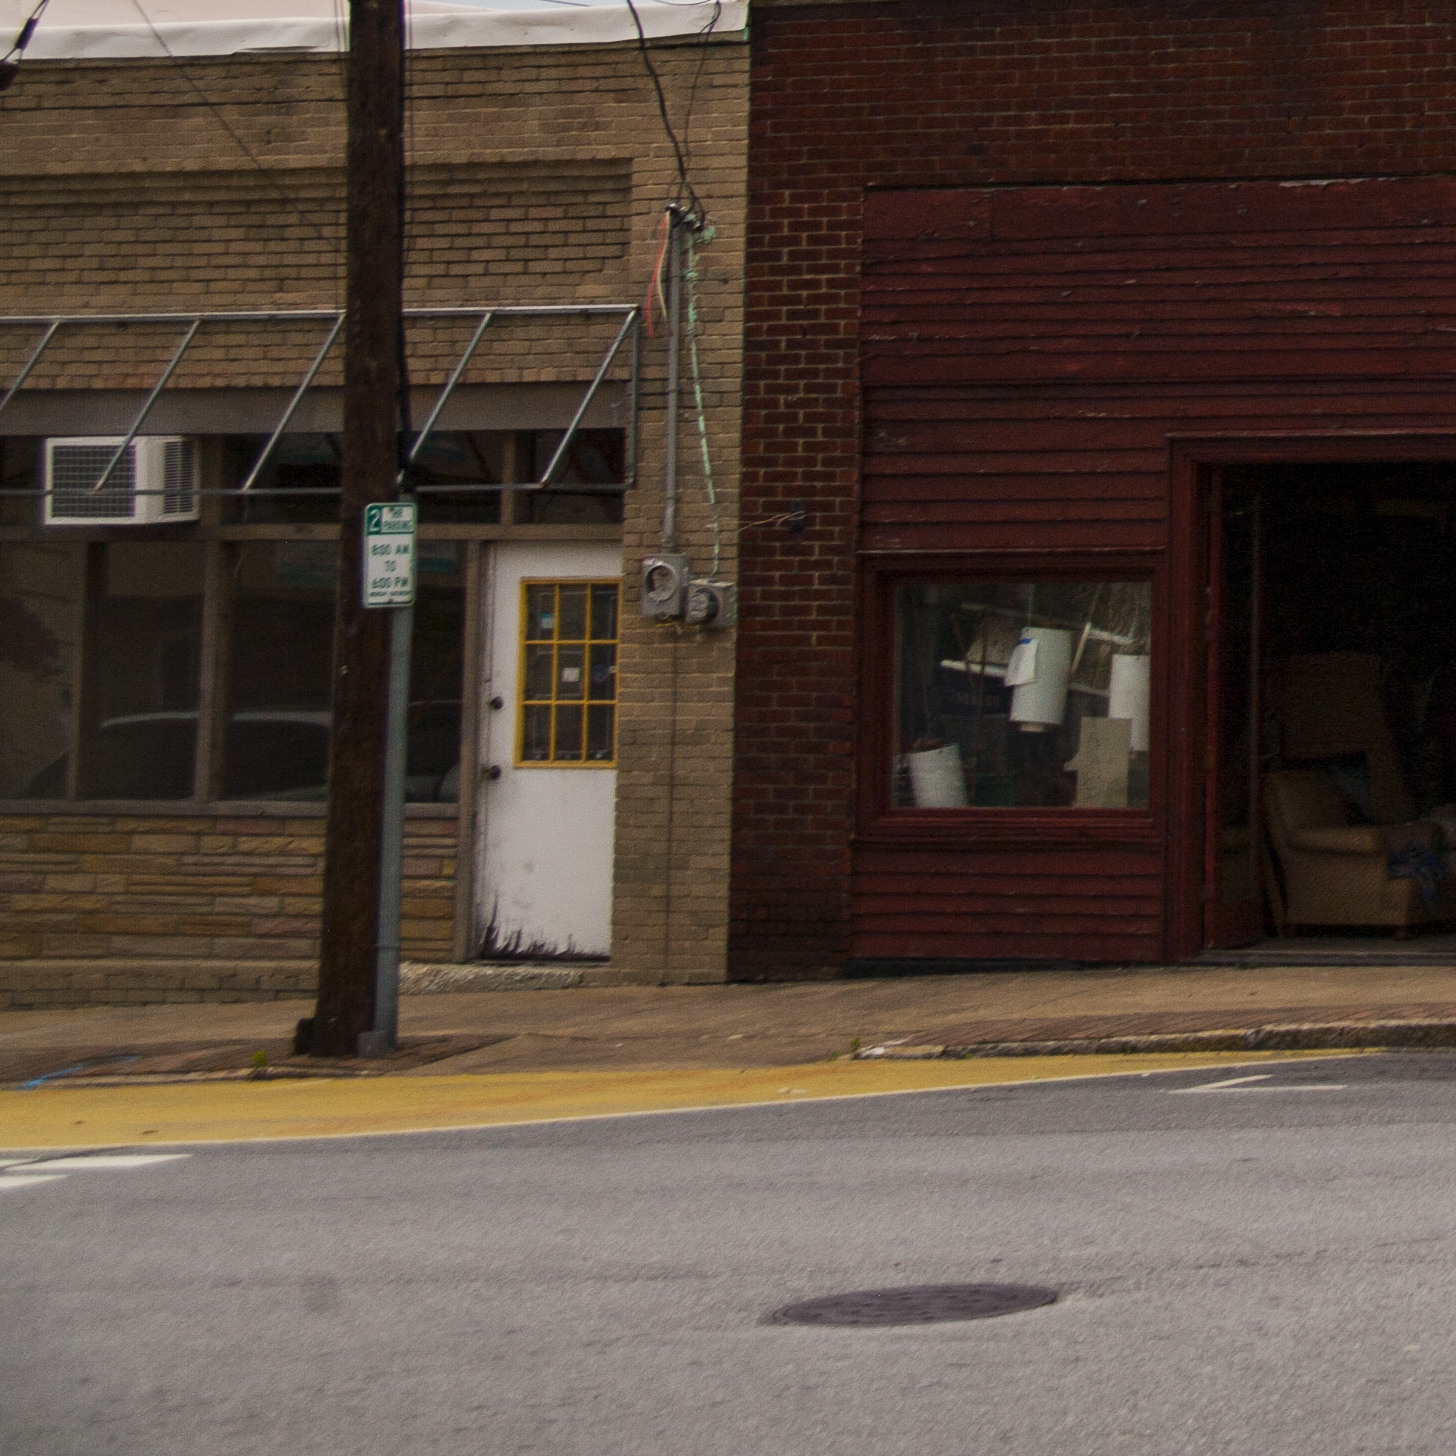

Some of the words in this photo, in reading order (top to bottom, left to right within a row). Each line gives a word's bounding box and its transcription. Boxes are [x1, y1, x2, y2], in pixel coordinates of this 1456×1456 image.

[370, 508, 381, 531] 2
[395, 545, 409, 555] AM
[385, 560, 396, 572] TO
[394, 576, 408, 588] PM
